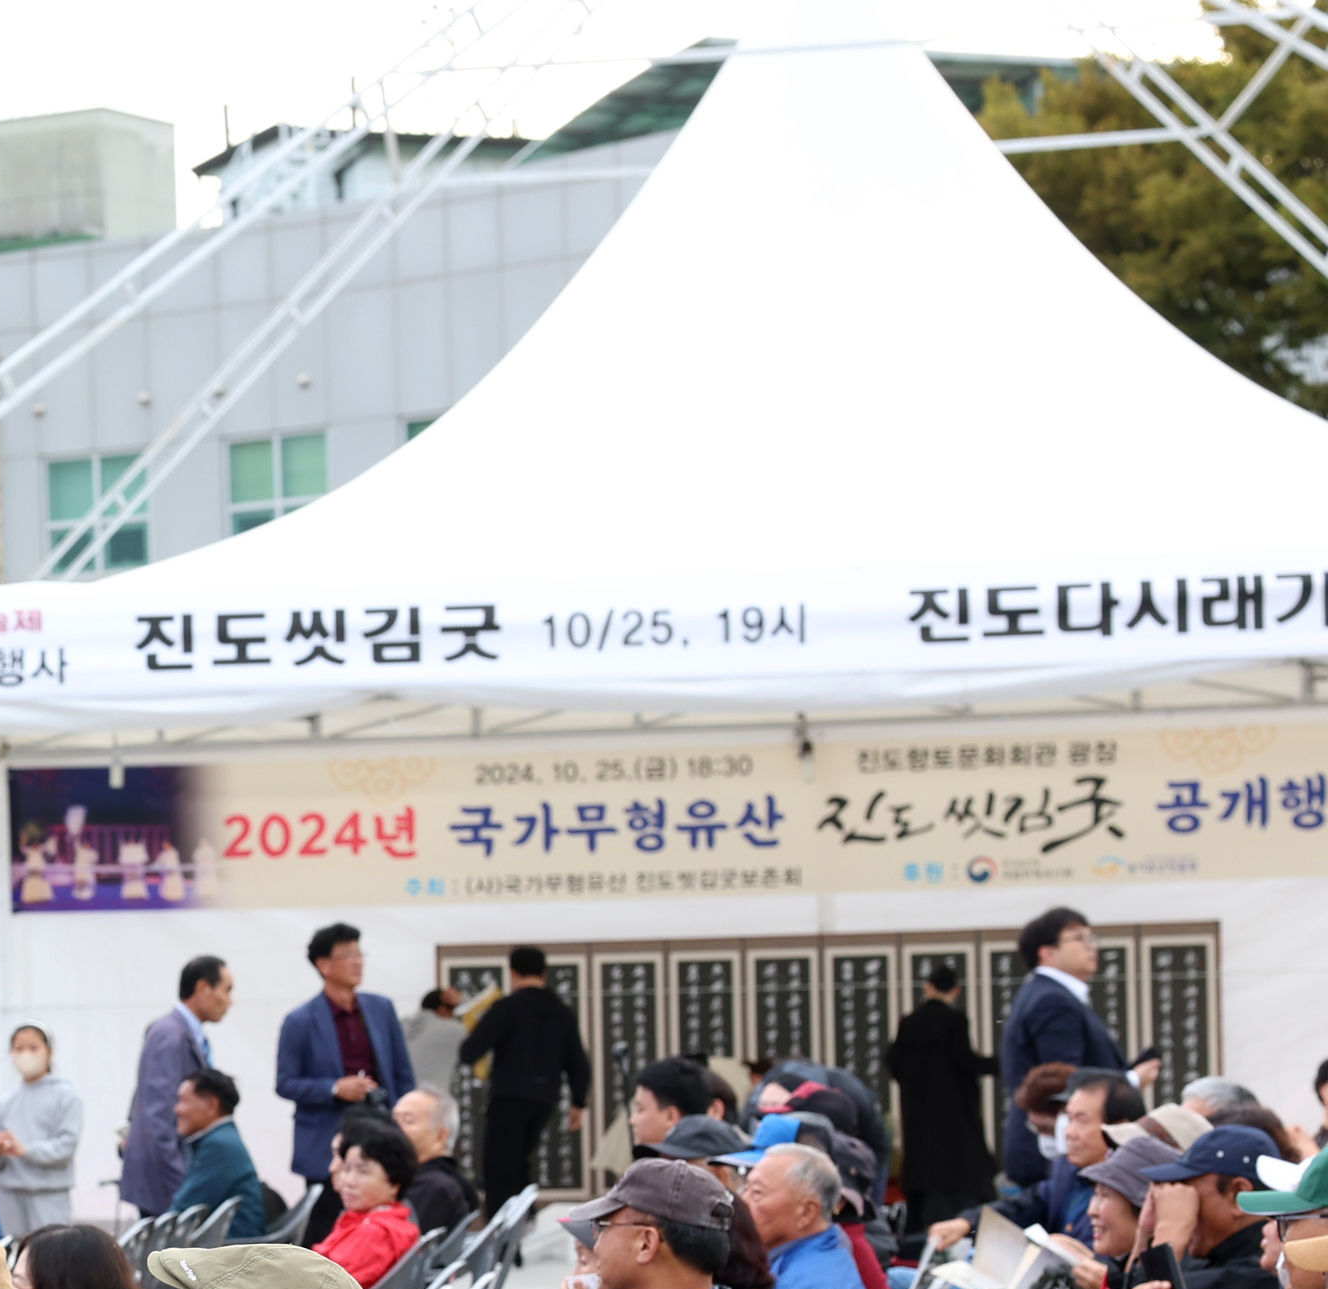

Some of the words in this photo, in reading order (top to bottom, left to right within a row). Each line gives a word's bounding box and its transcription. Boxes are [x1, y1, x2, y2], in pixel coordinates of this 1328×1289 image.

[136, 604, 501, 671] 진도씻김굿
[717, 603, 805, 645] 19시
[688, 753, 754, 778] 18:30
[857, 744, 1057, 773] 진도향토문화회관
[1070, 740, 1118, 766] 광장
[222, 806, 418, 860] 2024년
[449, 795, 784, 857] 국가무형유산
[816, 790, 936, 845] 진도
[944, 775, 1128, 853] 씻김굿
[1157, 772, 1328, 834] 공개행
